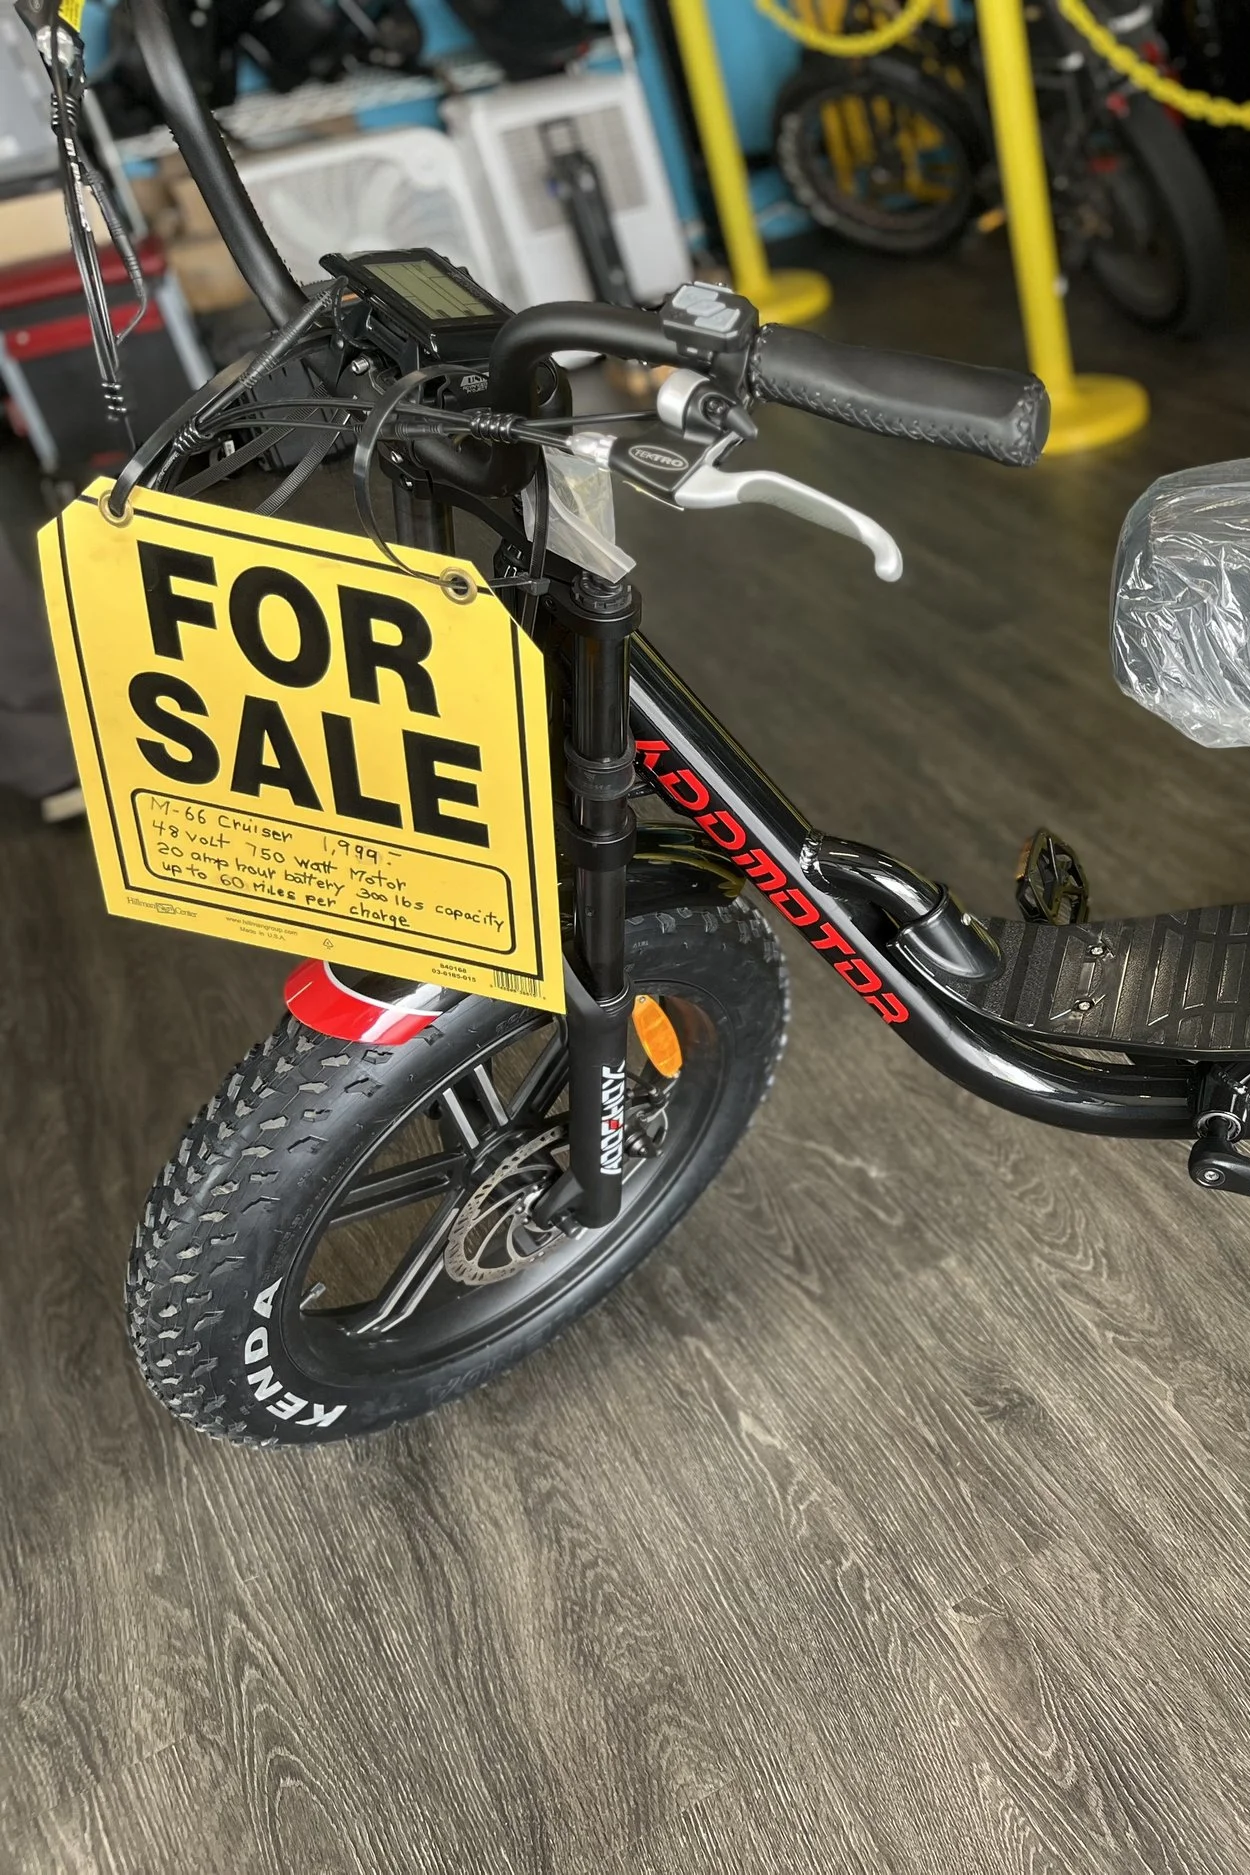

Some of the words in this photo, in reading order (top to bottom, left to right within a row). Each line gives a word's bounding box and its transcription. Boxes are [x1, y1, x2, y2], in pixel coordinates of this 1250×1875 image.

[635, 448, 684, 467] TEKTRO
[137, 539, 441, 718] FOR
[128, 671, 490, 849] SALE
[150, 797, 206, 824] M-66
[218, 815, 293, 843] Cruiser
[152, 819, 179, 838] 48
[246, 842, 285, 863] 750
[350, 868, 406, 891] Motor
[157, 842, 184, 858] 20
[190, 851, 229, 871] amp
[235, 857, 276, 880] hour
[284, 871, 345, 897] battery
[356, 887, 388, 902] 300
[395, 894, 424, 911] lbs
[435, 904, 505, 933] capacity
[162, 861, 182, 877] up
[186, 862, 207, 880] to
[220, 873, 244, 889] 60
[305, 894, 336, 911] per
[350, 902, 410, 930] charge
[245, 1277, 347, 1427] KENDA
